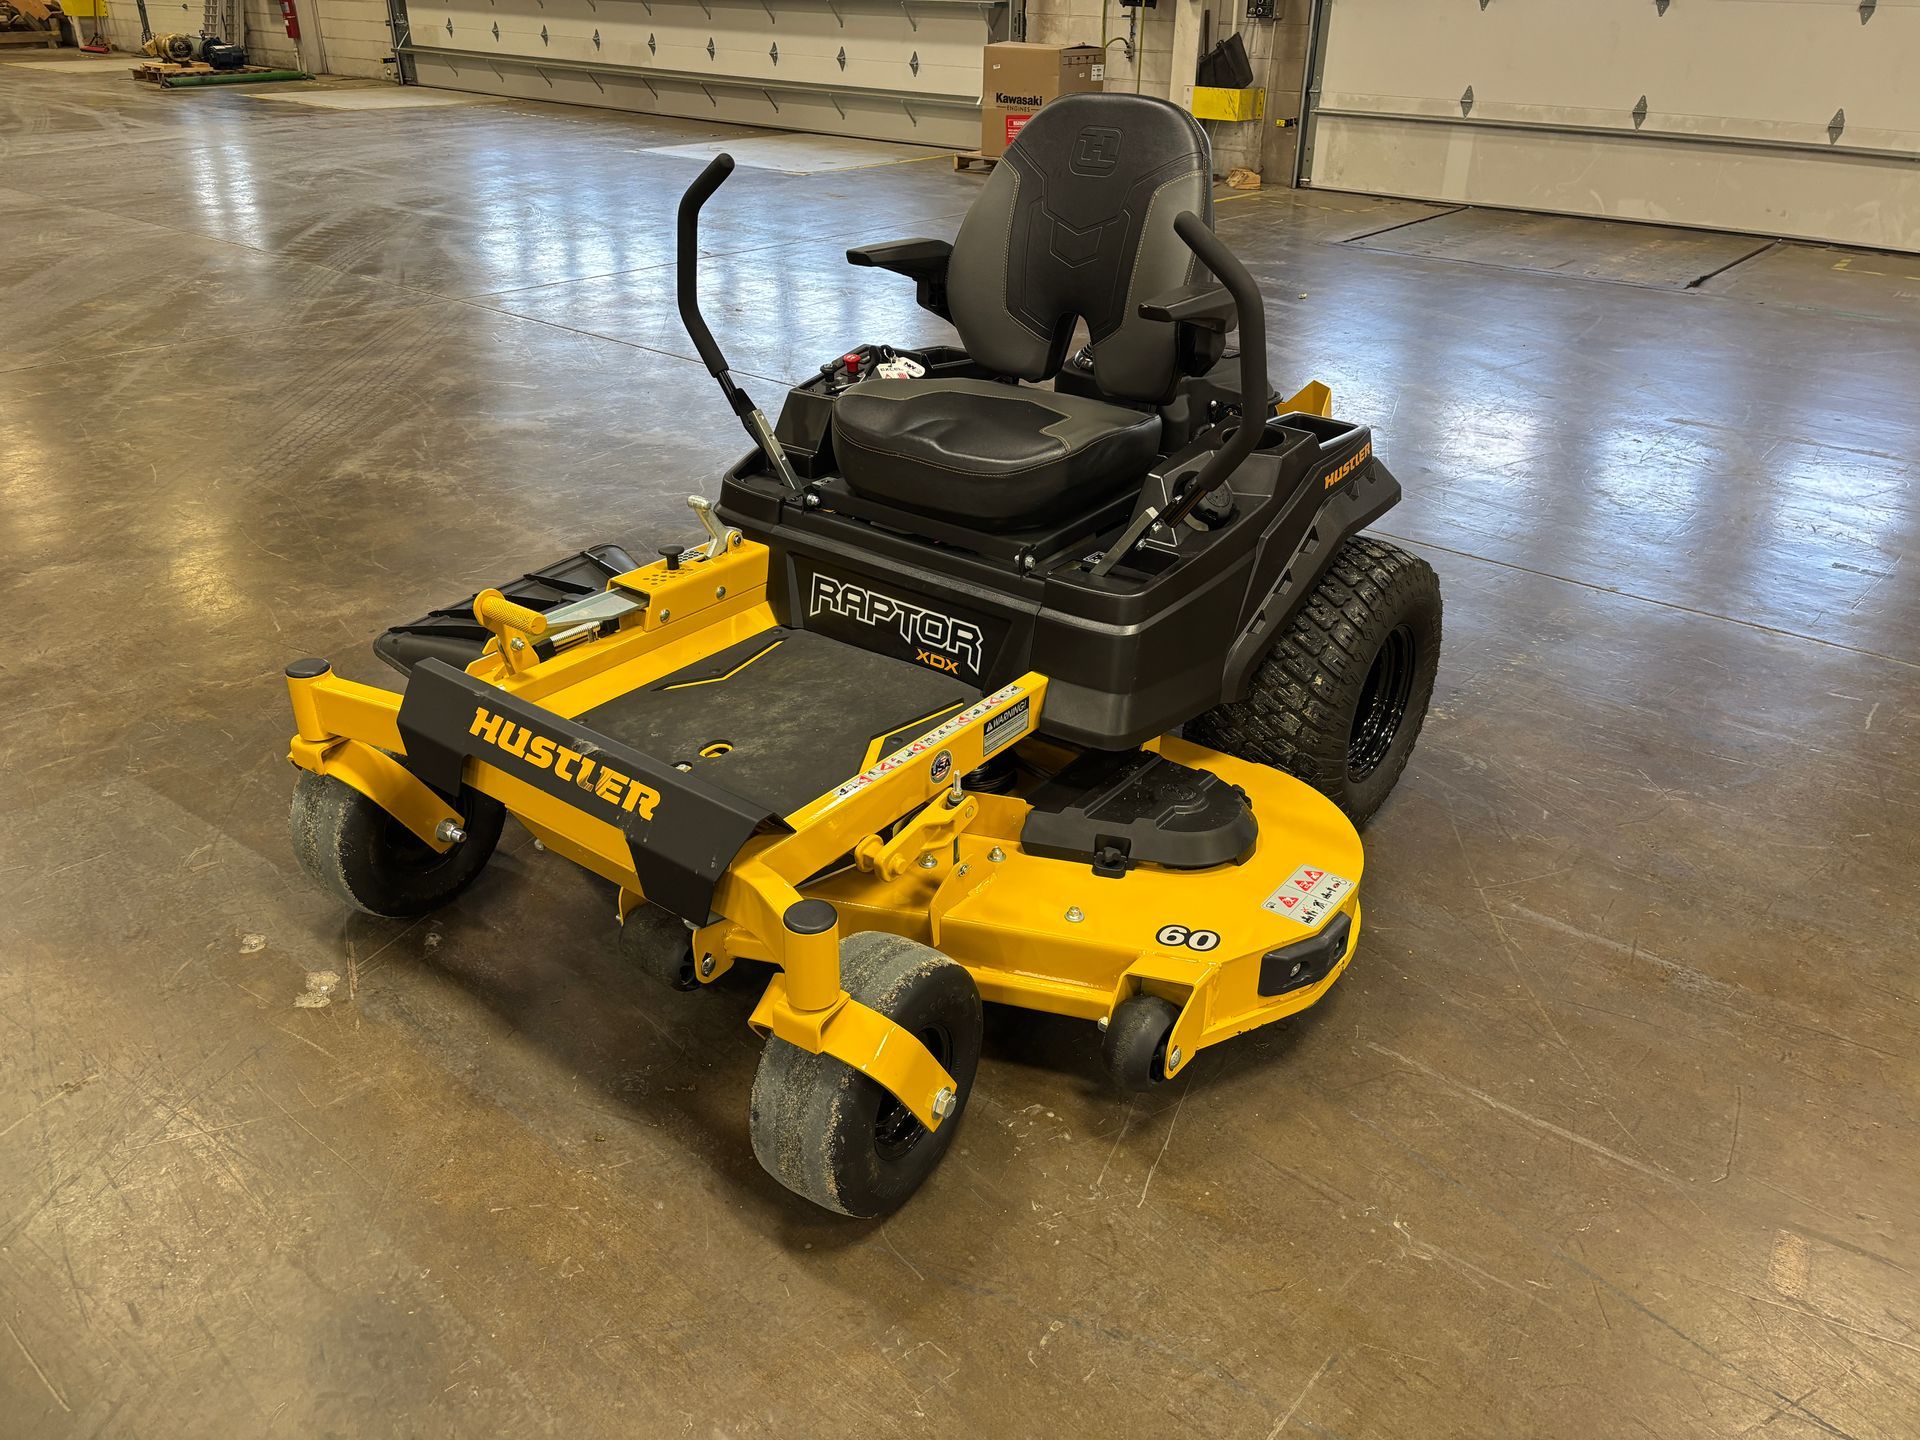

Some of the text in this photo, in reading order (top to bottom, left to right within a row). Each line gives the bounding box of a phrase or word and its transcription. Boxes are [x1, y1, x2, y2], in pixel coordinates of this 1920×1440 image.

[996, 93, 1042, 106] Kawasaki
[1325, 442, 1370, 490] HUSTLER
[810, 572, 984, 675] RAPTOR
[915, 648, 959, 675] XDX
[468, 706, 661, 821] HUSTLER
[931, 758, 951, 777] USA
[1155, 924, 1221, 952] 60
